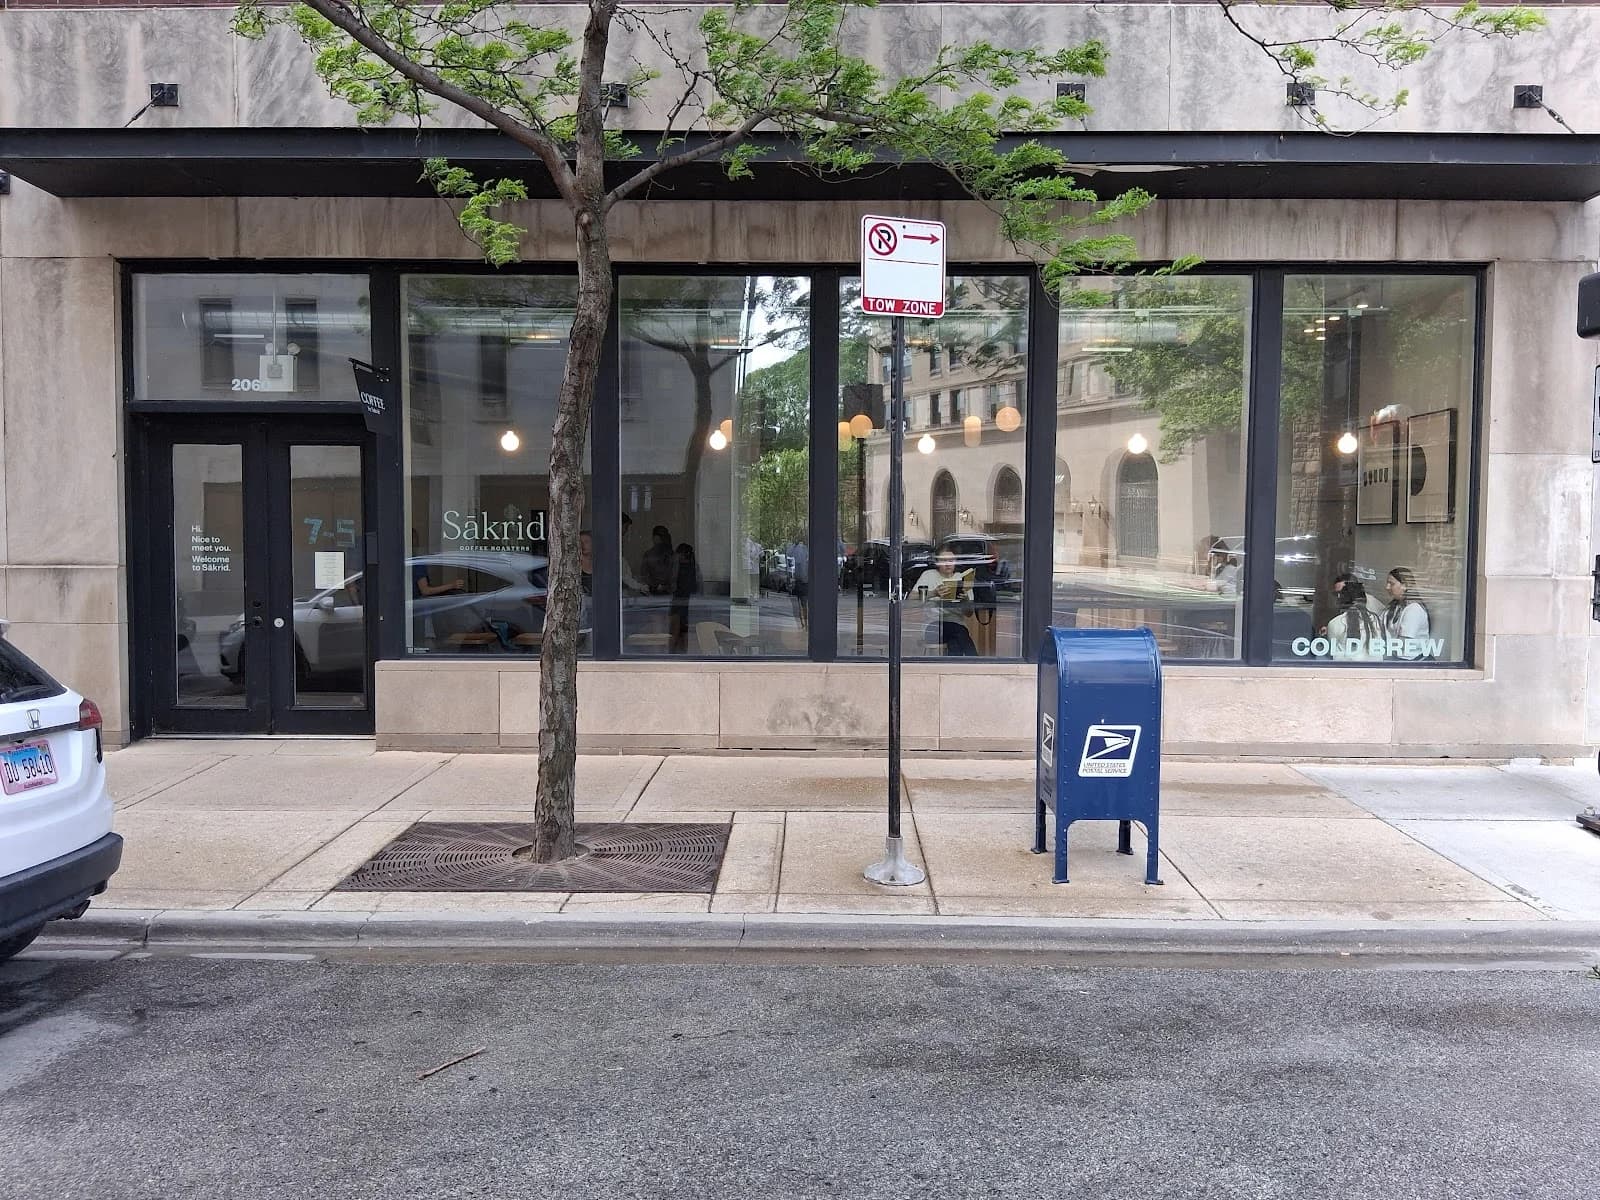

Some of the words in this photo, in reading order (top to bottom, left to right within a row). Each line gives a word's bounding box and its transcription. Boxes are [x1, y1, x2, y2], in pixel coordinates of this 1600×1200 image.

[868, 298, 895, 311] TOW
[902, 301, 937, 314] ZONE
[231, 378, 271, 391] 206
[360, 391, 386, 410] COFFEE
[191, 535, 210, 543] Nice
[214, 545, 231, 553] you.
[191, 555, 230, 563] Welcome
[1291, 637, 1362, 657] COLD
[1369, 638, 1445, 657] BREW
